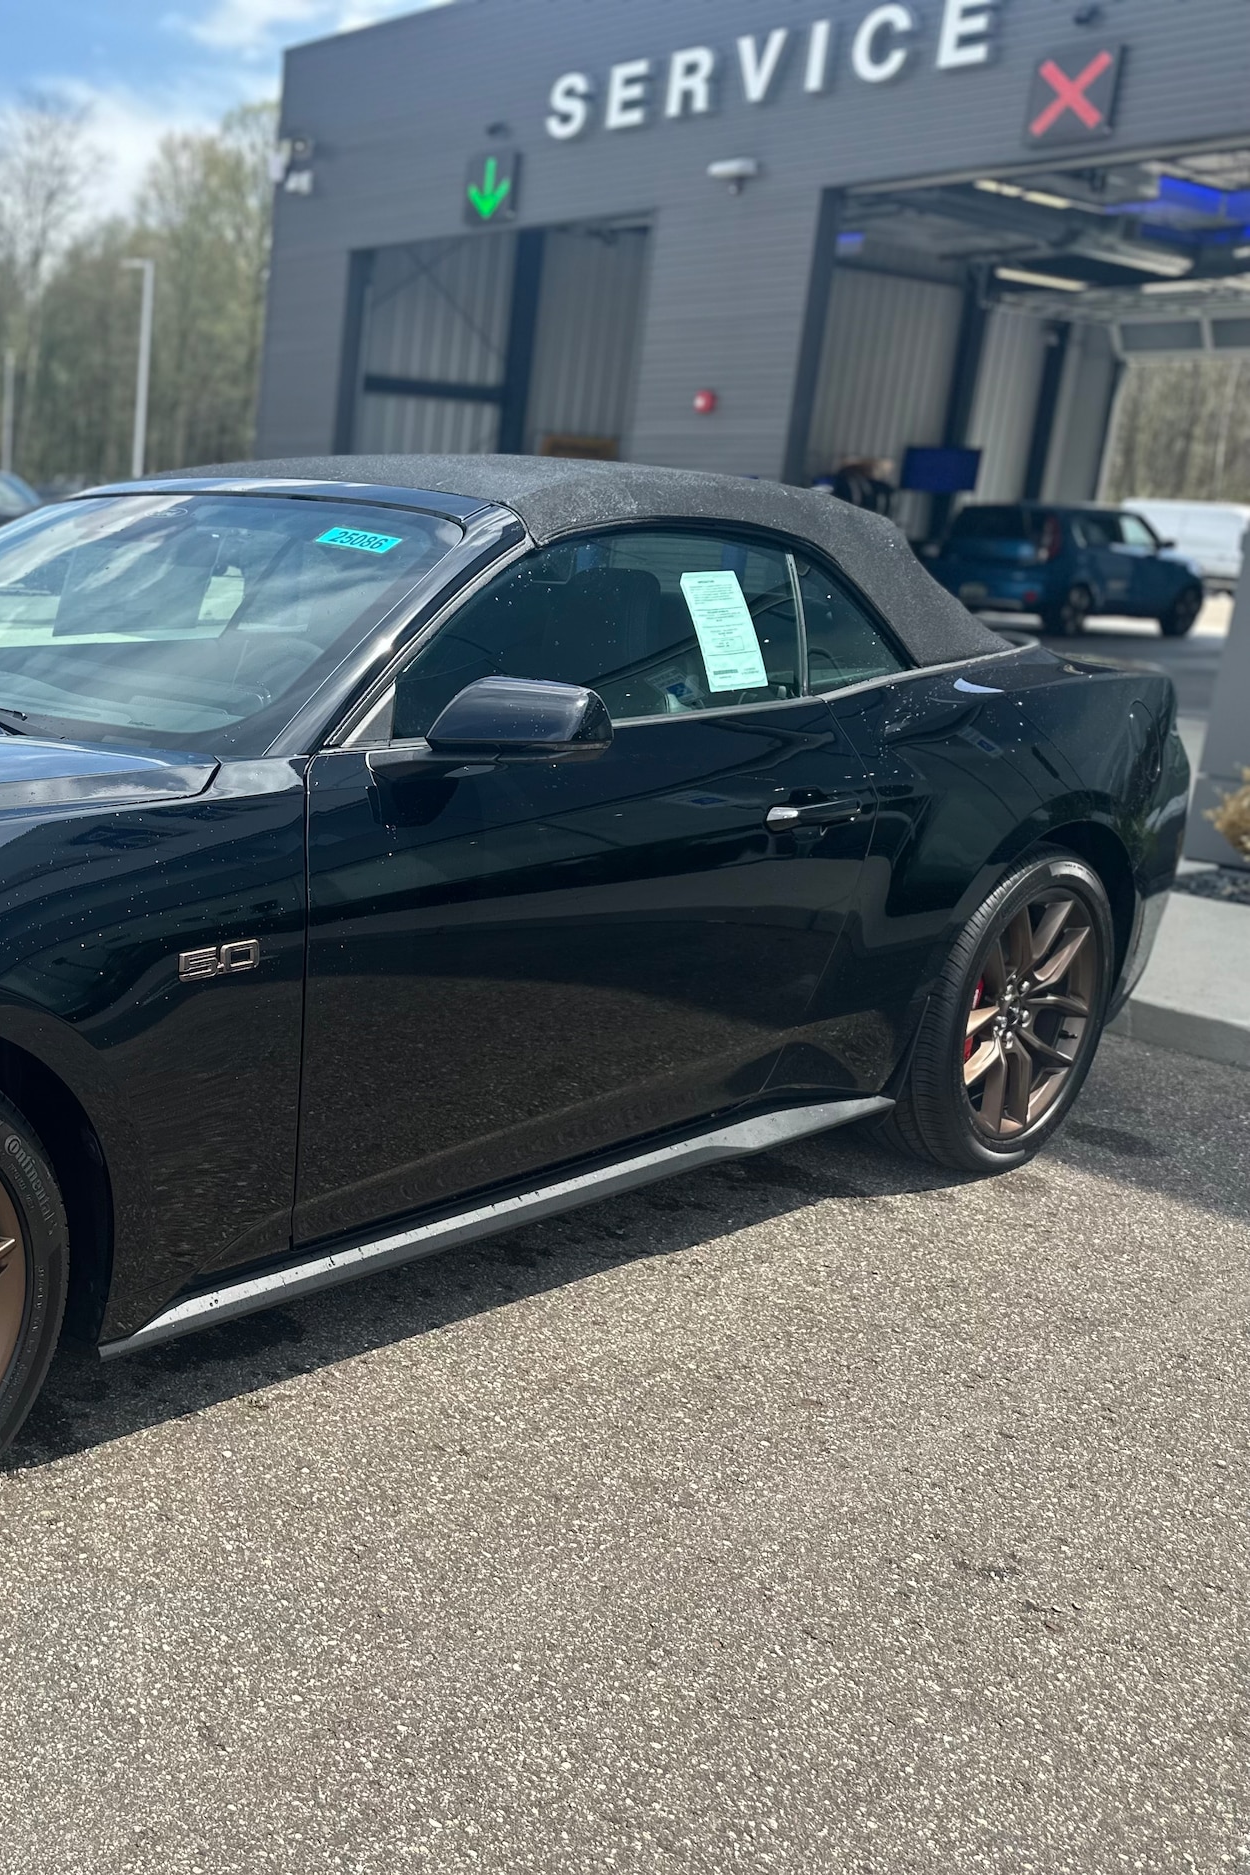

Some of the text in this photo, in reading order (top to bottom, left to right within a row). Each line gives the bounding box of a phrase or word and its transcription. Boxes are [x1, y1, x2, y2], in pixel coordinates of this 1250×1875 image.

[545, 0, 995, 139] SERVICE
[328, 531, 389, 550] 25086
[178, 939, 260, 982] 5.0
[4, 1134, 55, 1221] Continental
